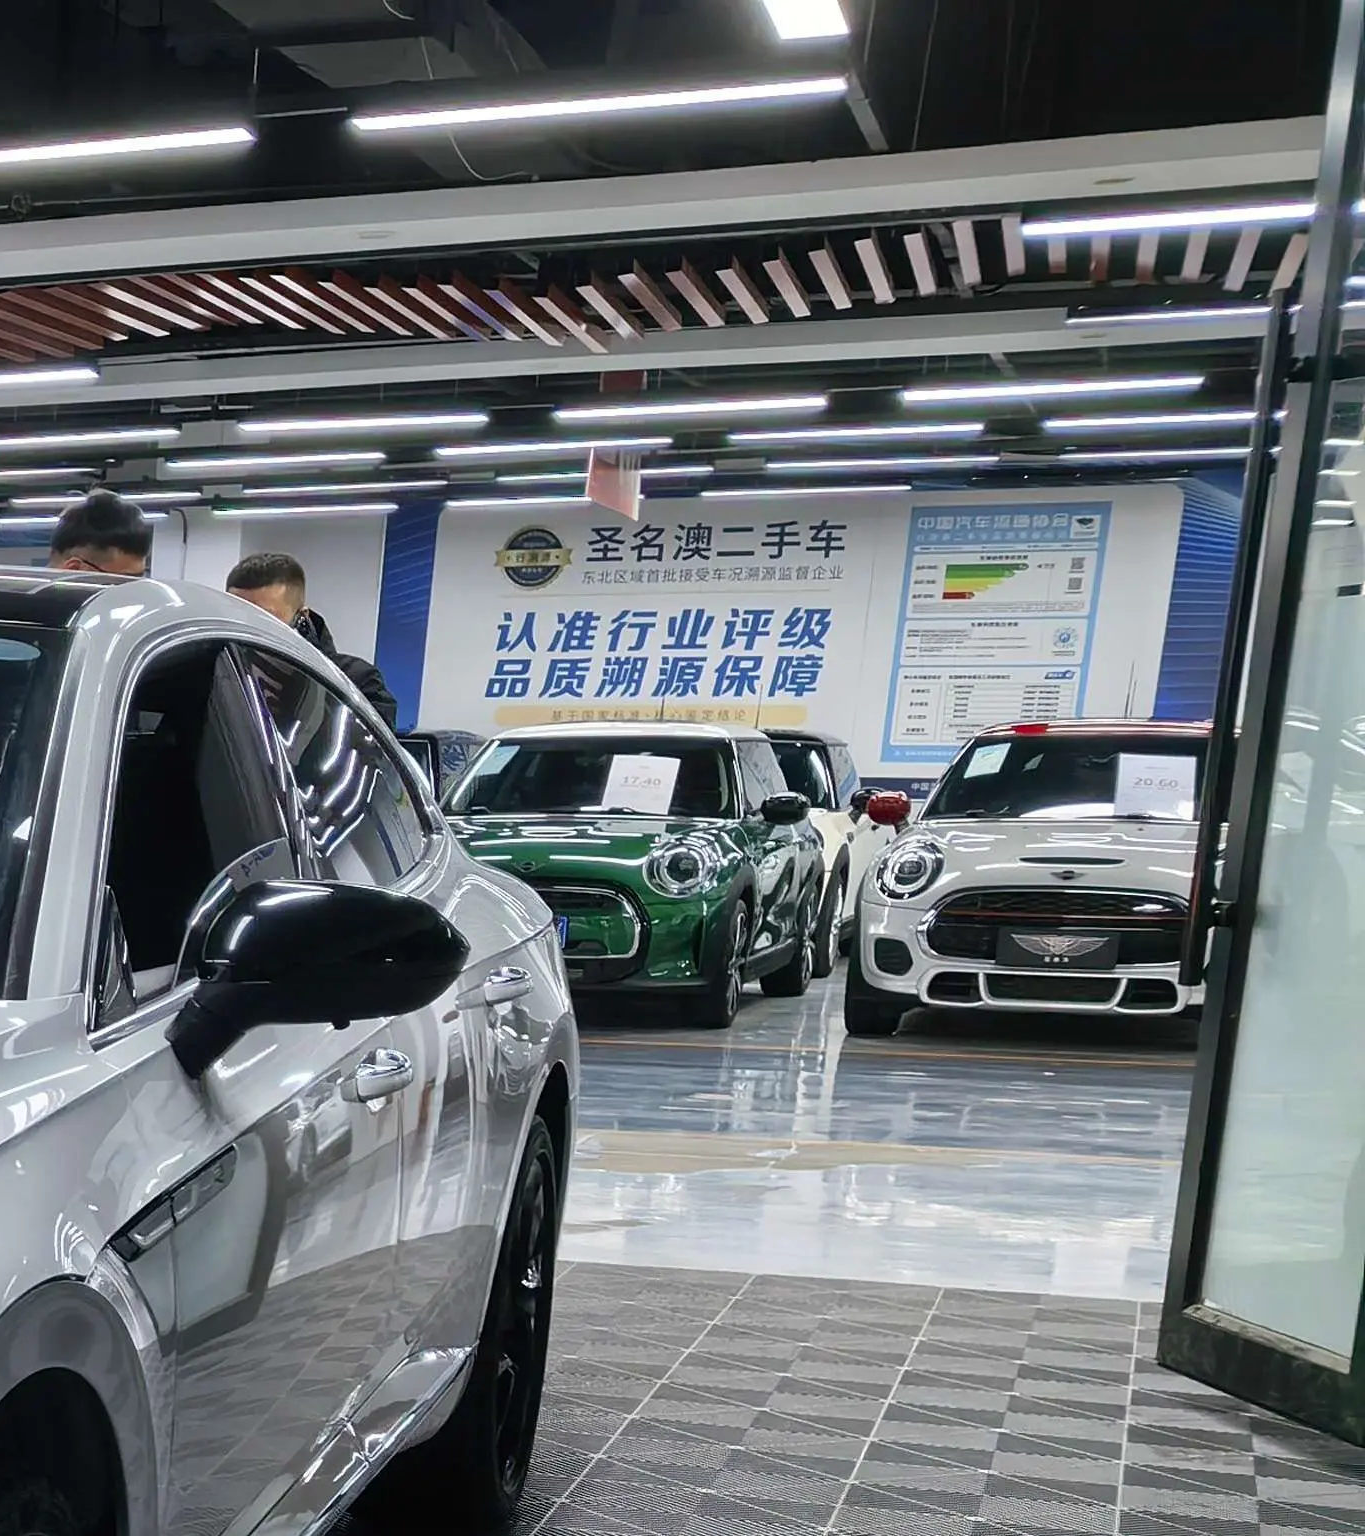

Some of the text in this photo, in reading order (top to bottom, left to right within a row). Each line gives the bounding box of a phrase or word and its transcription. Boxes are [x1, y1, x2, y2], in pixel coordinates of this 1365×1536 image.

[585, 519, 848, 563] 圣名澳二手车
[581, 567, 844, 585] 东北区域首批接受车况溯源监督企业
[495, 607, 832, 652] 认准行业评级
[484, 654, 824, 698] 品质溯源保障
